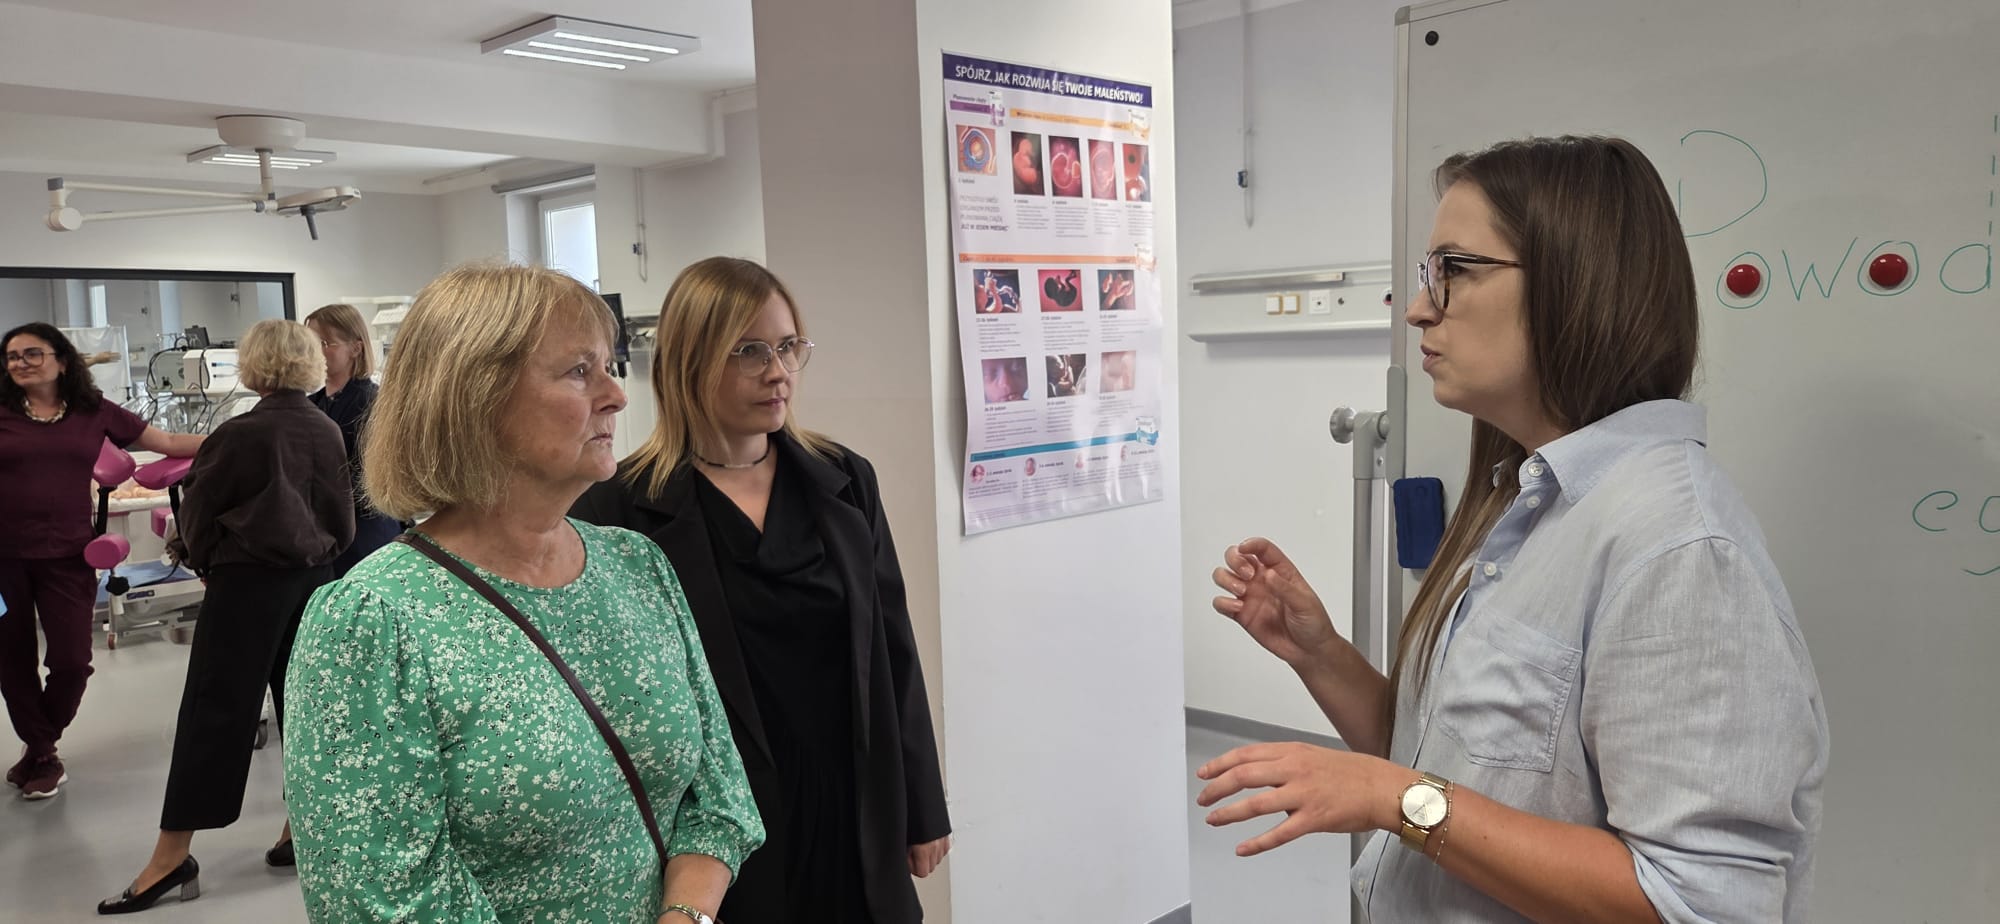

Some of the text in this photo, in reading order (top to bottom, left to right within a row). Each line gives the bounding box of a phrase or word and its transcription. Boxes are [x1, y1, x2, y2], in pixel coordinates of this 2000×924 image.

[955, 65, 1143, 104] SPÓJRZ, JAK ROZWIJA SIĘ TWOJE MALEŃSTWO!
